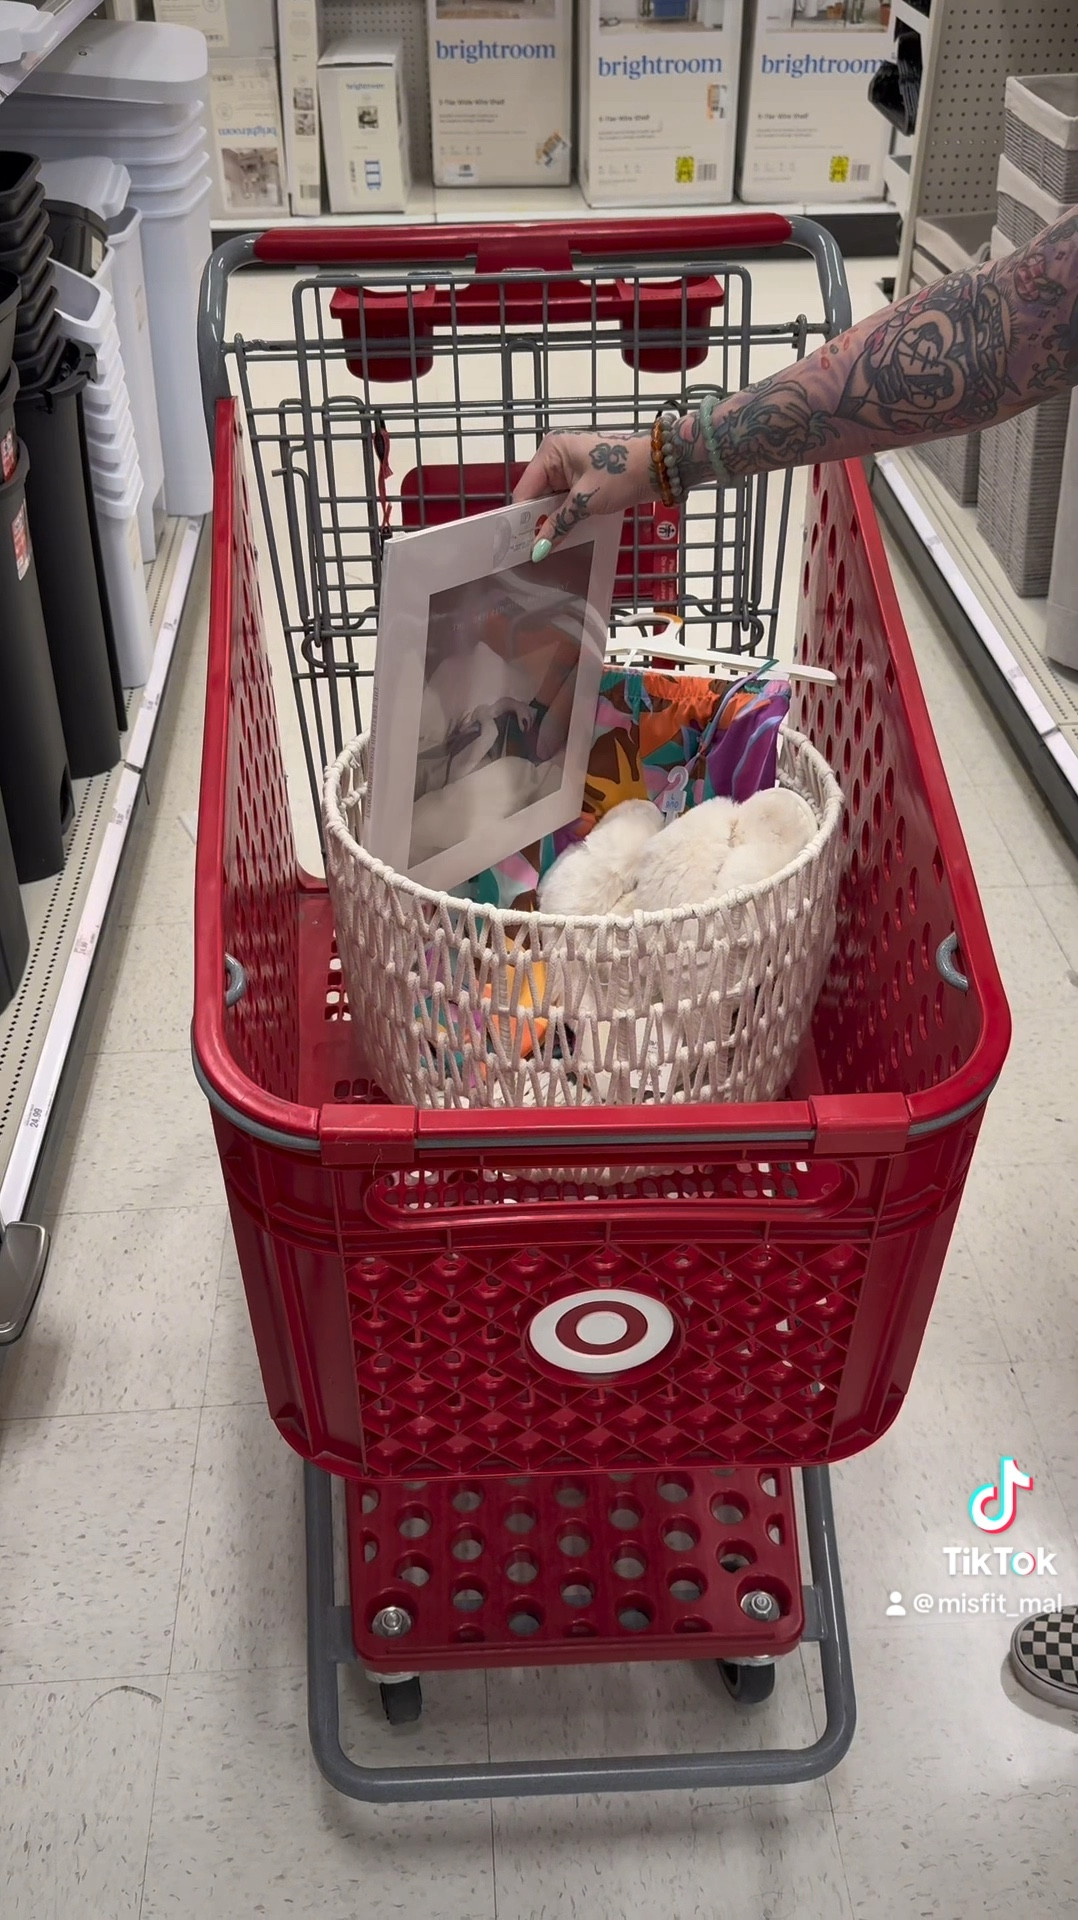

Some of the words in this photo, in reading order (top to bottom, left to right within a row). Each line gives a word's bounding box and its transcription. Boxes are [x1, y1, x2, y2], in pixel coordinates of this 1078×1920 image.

[436, 40, 556, 64] brightroom
[598, 55, 722, 80] brightroom
[761, 53, 886, 79] brightroom
[218, 125, 277, 137] brightroom
[29, 1107, 43, 1129] 24.99
